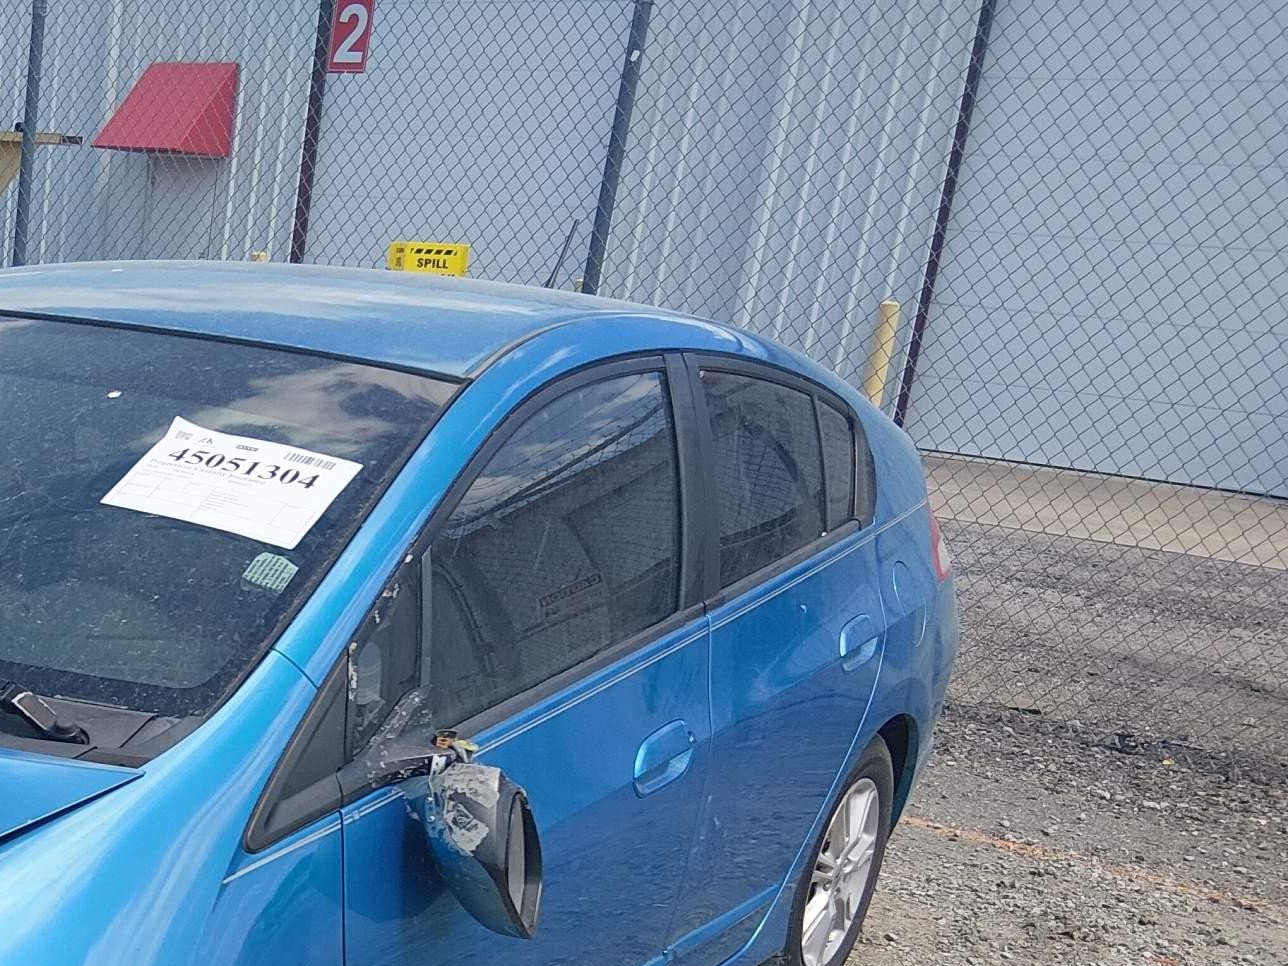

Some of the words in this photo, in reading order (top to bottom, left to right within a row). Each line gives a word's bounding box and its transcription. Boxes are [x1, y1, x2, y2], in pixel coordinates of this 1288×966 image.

[333, 3, 369, 63] 2
[416, 258, 449, 269] SPILL
[168, 447, 321, 489] 45051304
